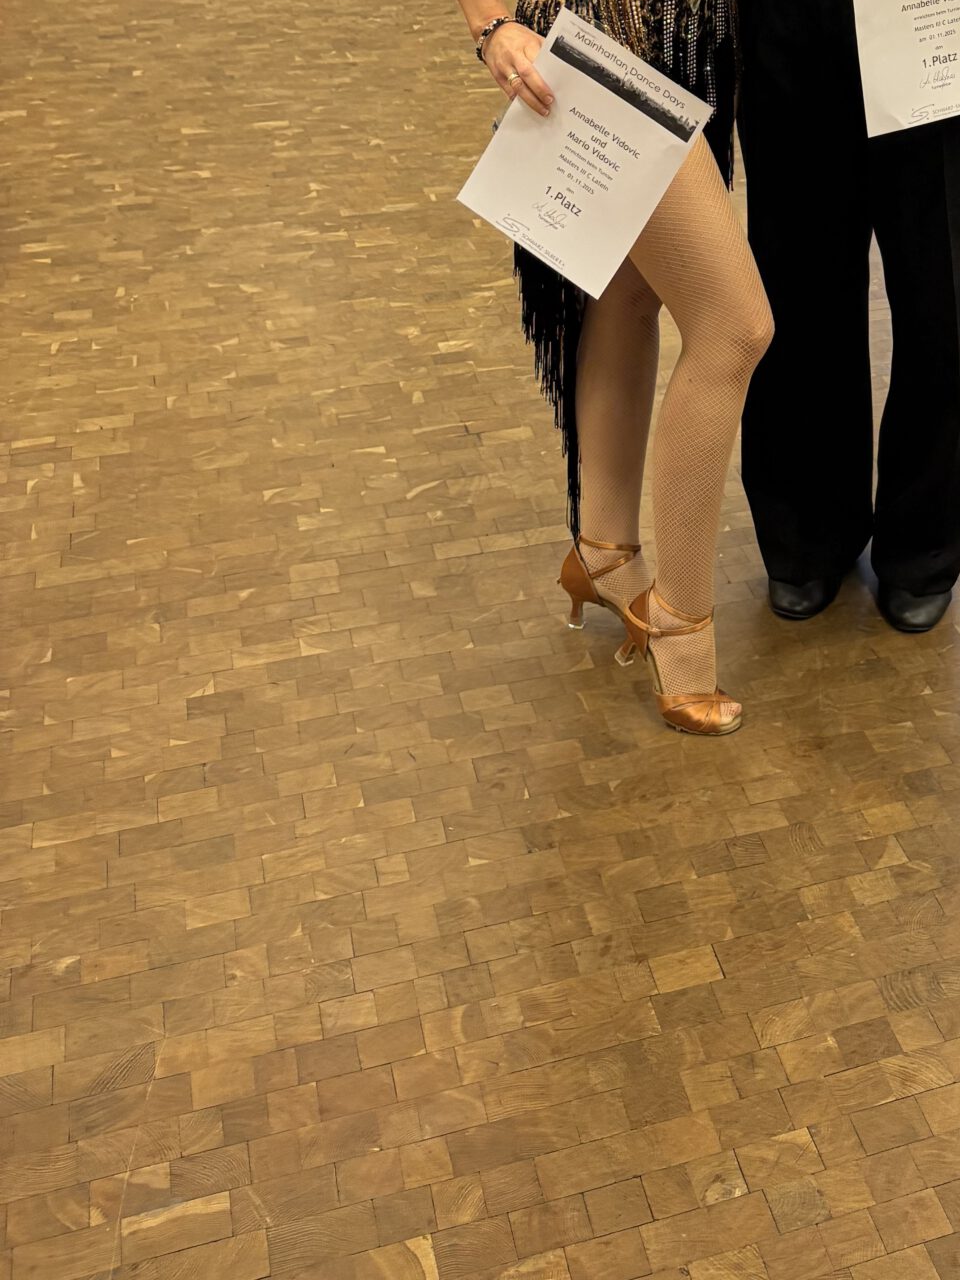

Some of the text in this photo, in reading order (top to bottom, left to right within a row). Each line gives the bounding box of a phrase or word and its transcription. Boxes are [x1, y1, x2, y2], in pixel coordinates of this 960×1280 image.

[574, 31, 686, 109] Mainhattan Dance Days
[567, 130, 621, 172] Mario Vidovic
[569, 106, 641, 160] Annabelle Vidovic
[590, 135, 608, 149] und
